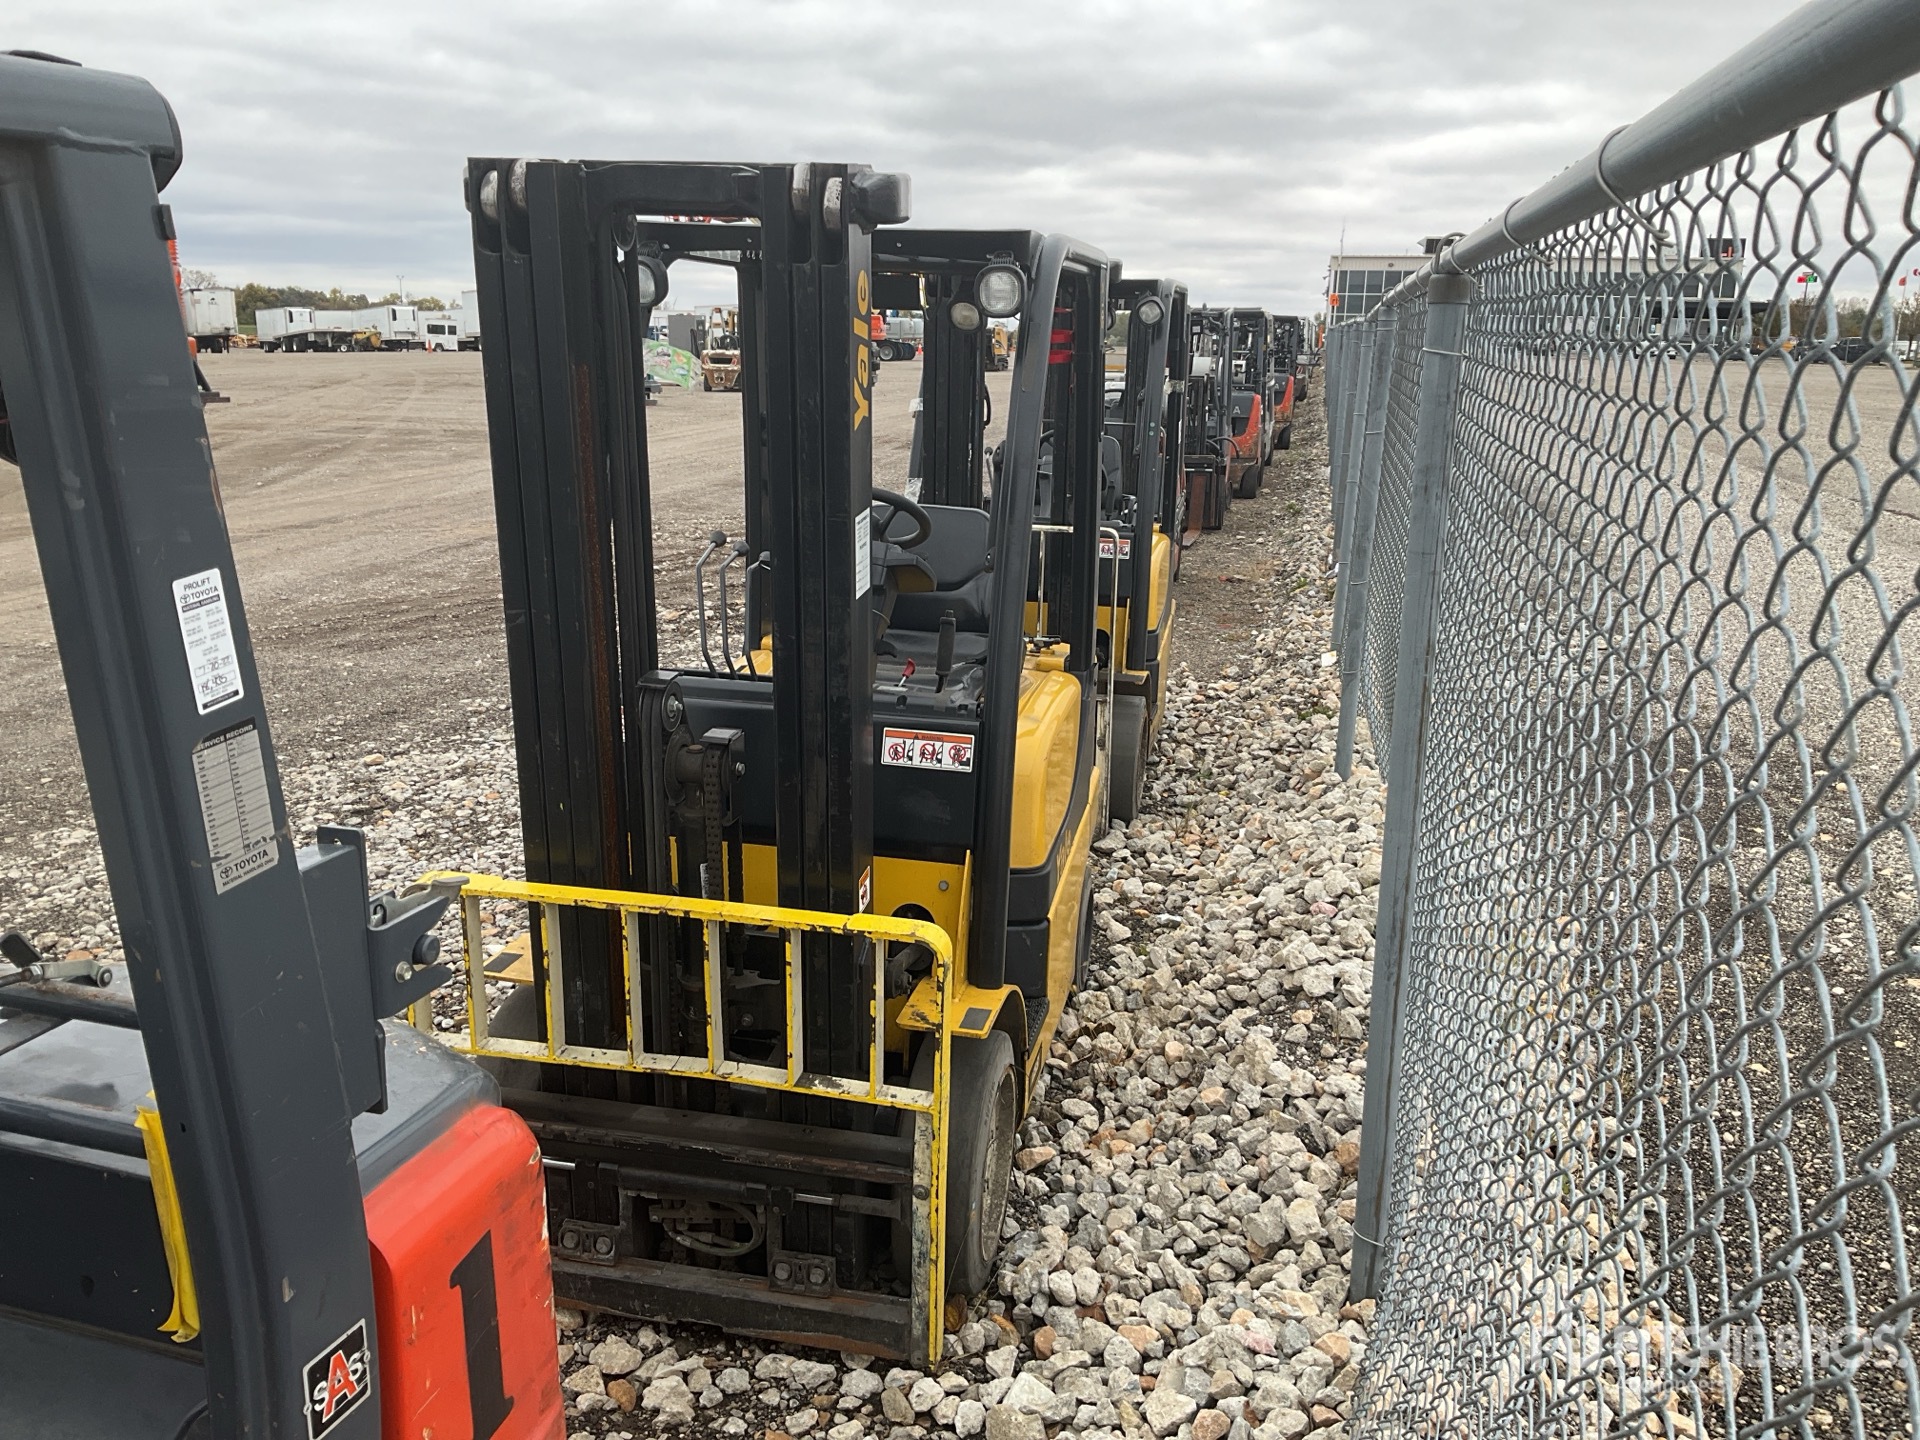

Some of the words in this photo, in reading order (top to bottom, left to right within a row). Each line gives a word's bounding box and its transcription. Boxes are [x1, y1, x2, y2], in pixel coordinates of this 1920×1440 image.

[853, 269, 869, 432] Yale
[183, 576, 211, 592] PROLIFT
[191, 585, 219, 600] TOYOTA
[225, 724, 254, 739] RECORD
[233, 849, 269, 872] TOYOTA
[222, 874, 243, 887] MATERIAL
[243, 863, 264, 877] HANDLING
